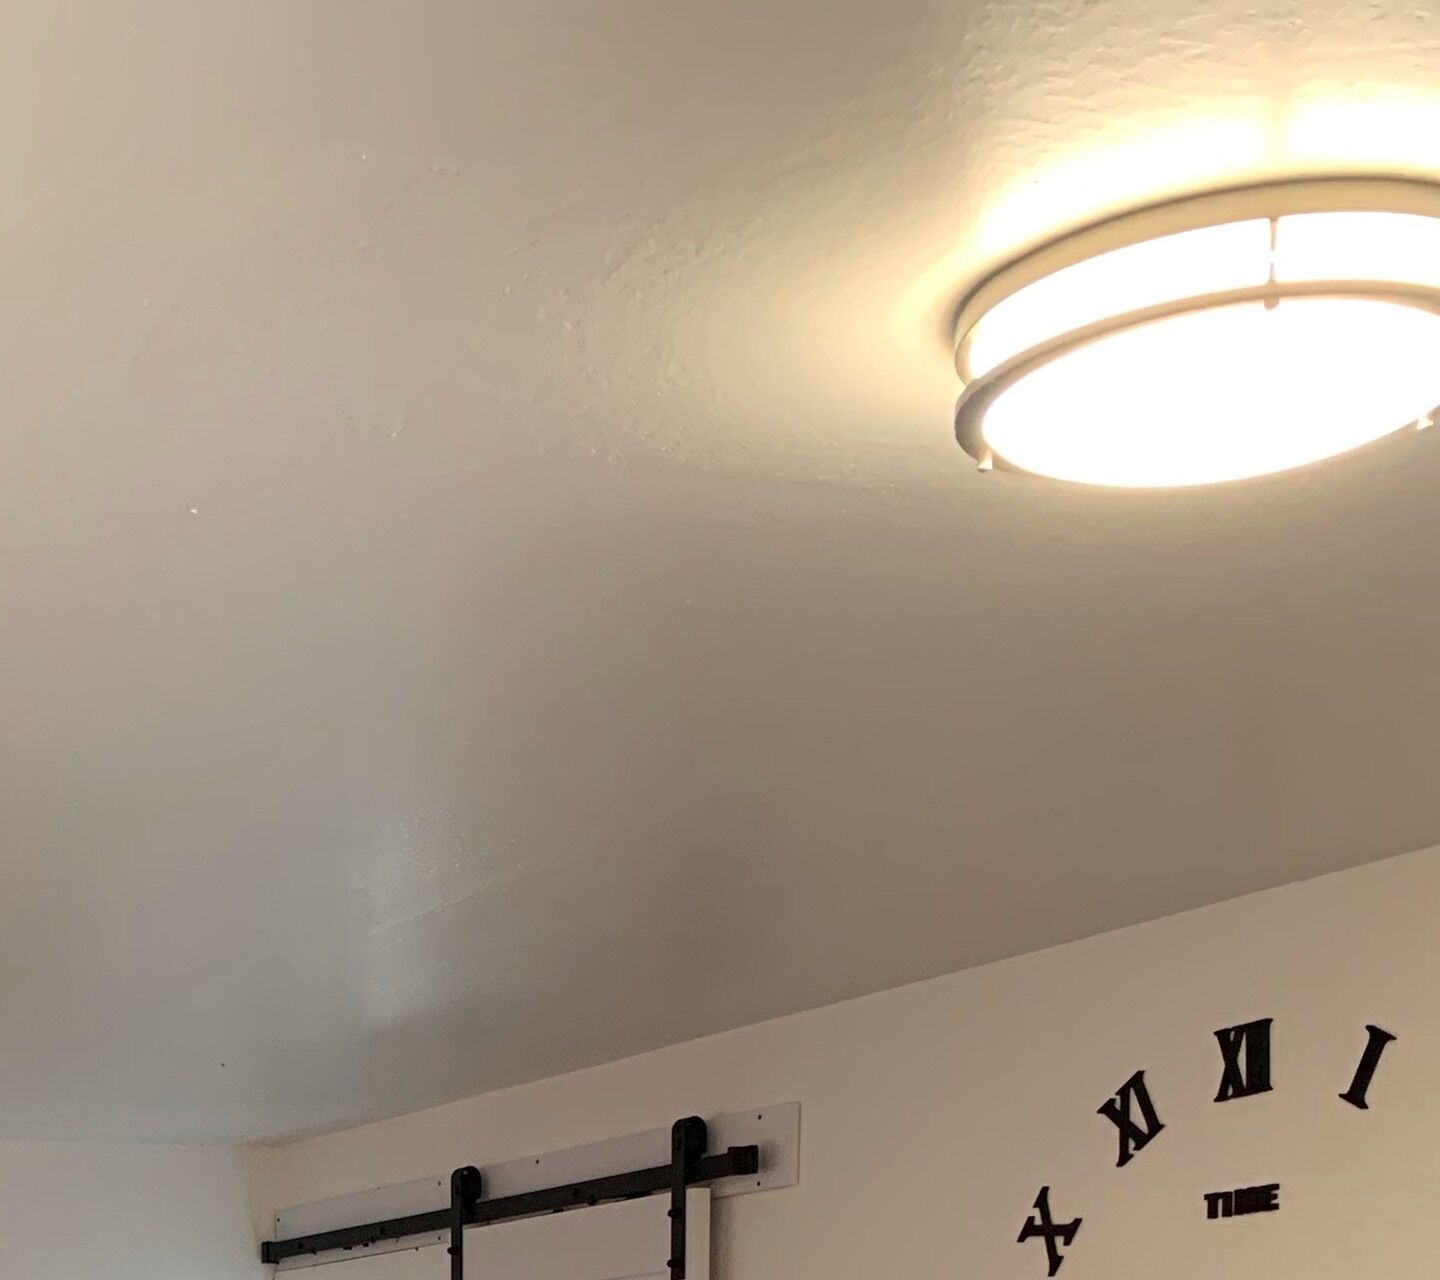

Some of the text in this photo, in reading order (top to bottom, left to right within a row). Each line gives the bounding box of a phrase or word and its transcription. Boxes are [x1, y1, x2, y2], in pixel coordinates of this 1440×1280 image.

[1214, 1018, 1274, 1103] XII
[1338, 1024, 1397, 1110] I
[1096, 1070, 1166, 1168] XI
[1016, 1185, 1083, 1278] X
[1203, 1183, 1281, 1220] TIME
